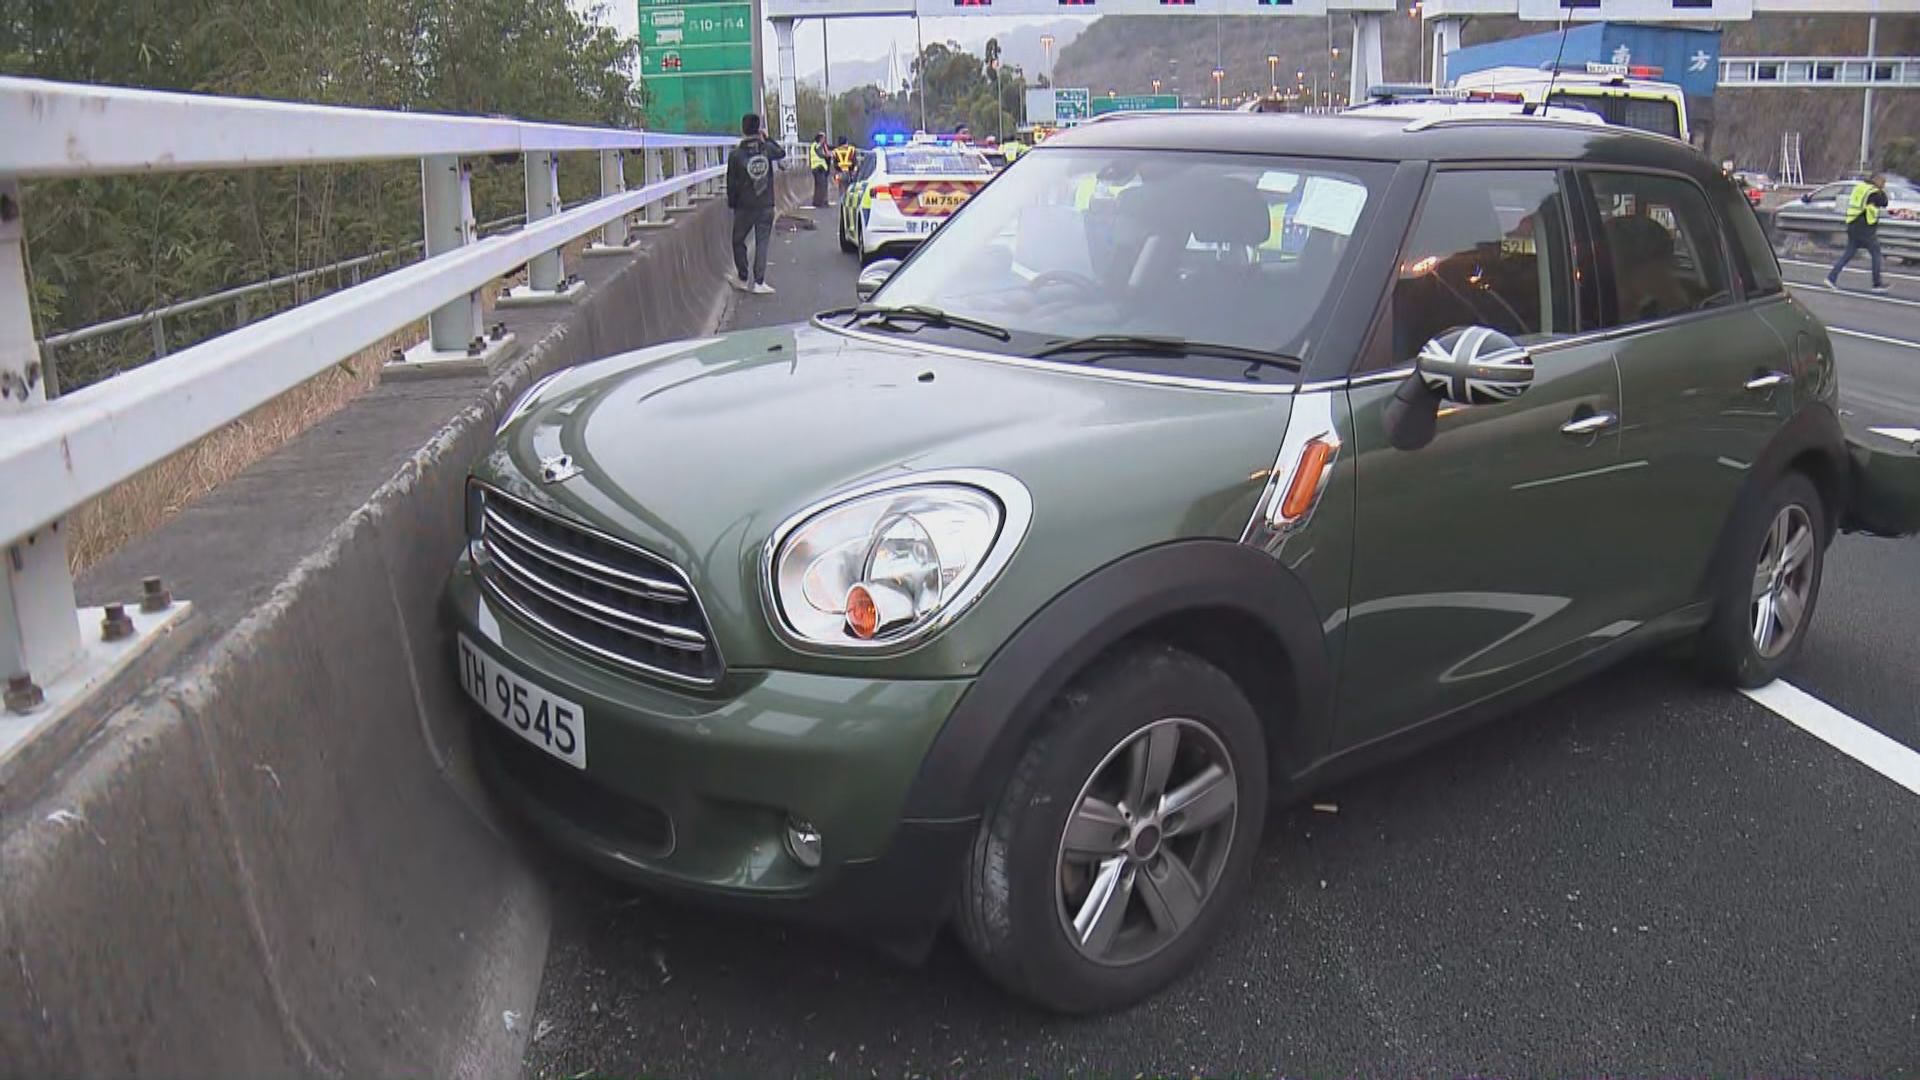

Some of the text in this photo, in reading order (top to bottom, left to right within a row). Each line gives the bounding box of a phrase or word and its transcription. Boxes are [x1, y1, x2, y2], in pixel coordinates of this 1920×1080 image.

[736, 18, 745, 29] 4
[461, 643, 577, 756] TH 9545
